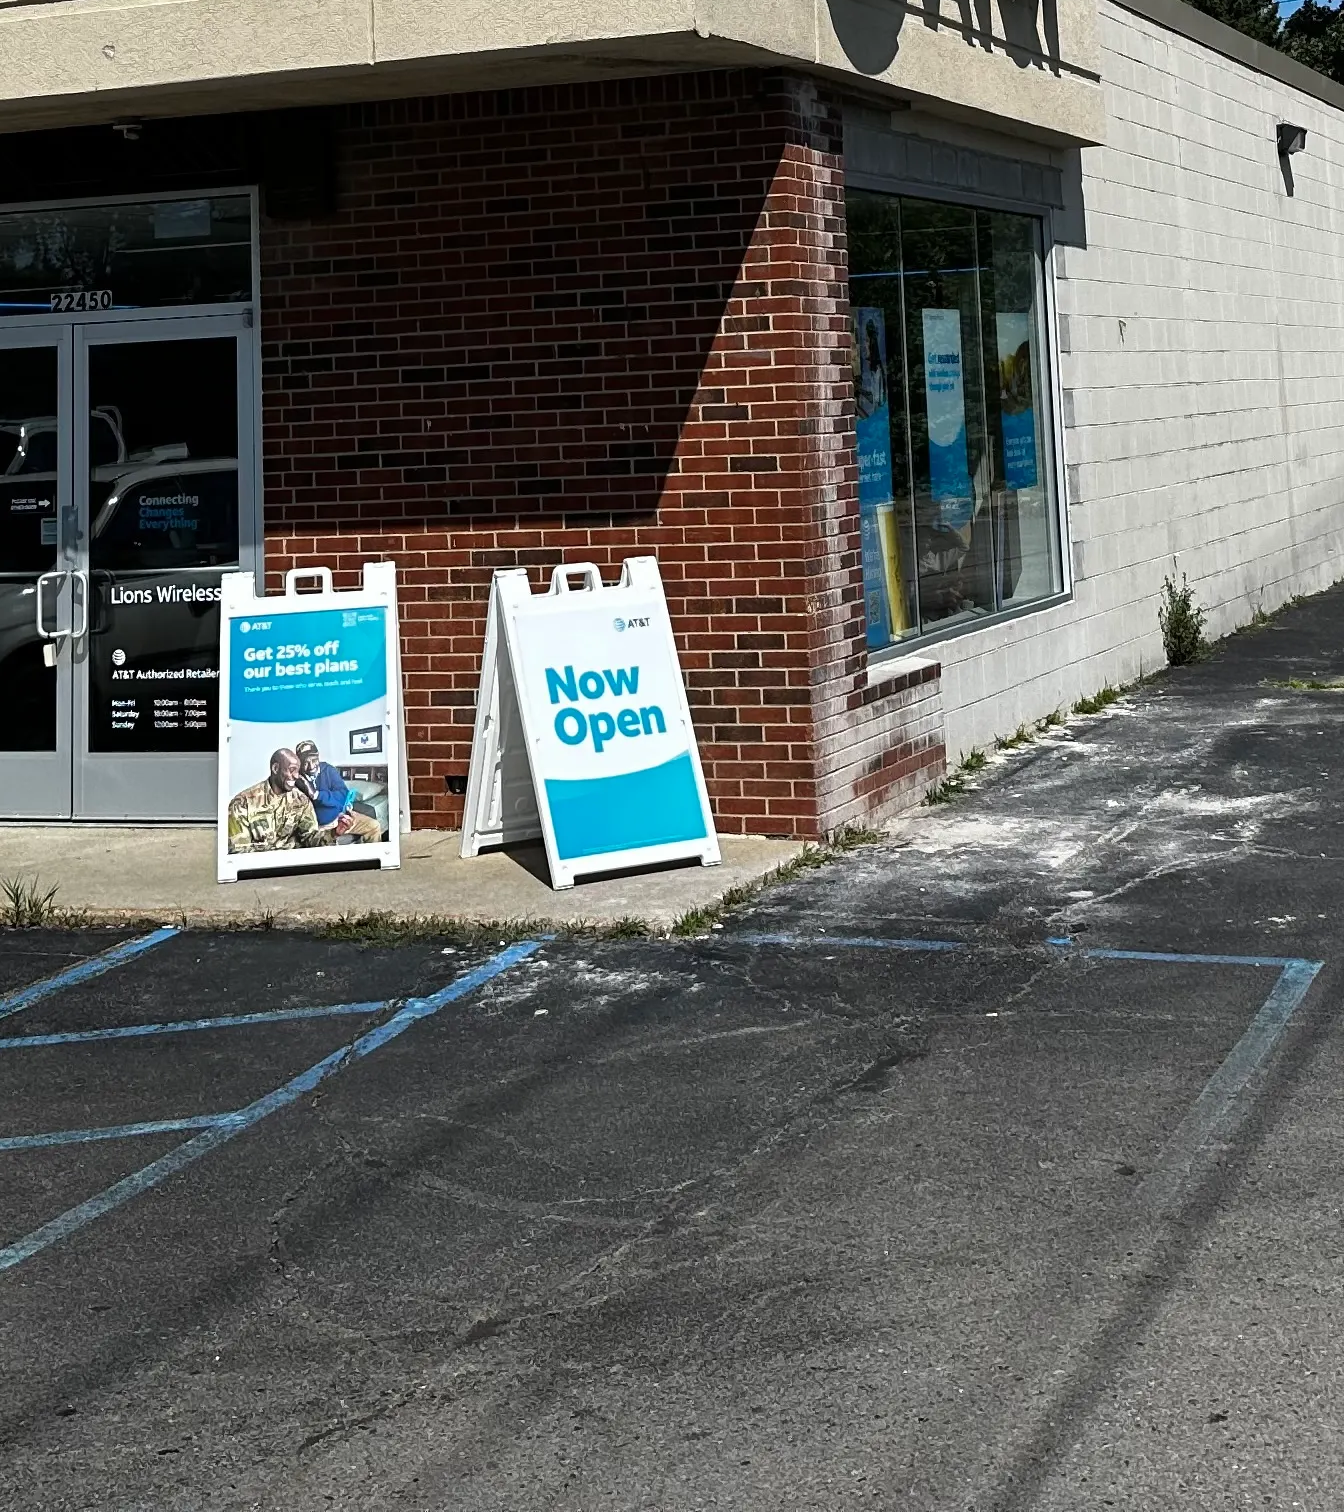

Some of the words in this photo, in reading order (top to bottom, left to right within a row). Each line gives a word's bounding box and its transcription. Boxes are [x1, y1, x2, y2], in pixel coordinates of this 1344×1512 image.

[51, 290, 112, 312] 22450
[138, 493, 200, 506] Connecting
[139, 507, 184, 519] Changes
[139, 517, 199, 531] Everything
[111, 586, 153, 605] Lions
[156, 584, 222, 604] Wireless
[251, 622, 272, 631] AT&T
[627, 617, 651, 628] AT&T
[243, 646, 273, 661] Get
[276, 643, 310, 660] 25%
[314, 640, 340, 656] off
[112, 669, 136, 680] AT&T
[136, 669, 185, 680] Authorized
[186, 668, 220, 679] Retailer
[243, 666, 272, 680] our
[275, 662, 311, 677] best
[314, 659, 359, 677] plans
[544, 665, 640, 704] Now
[554, 705, 667, 753] Open
